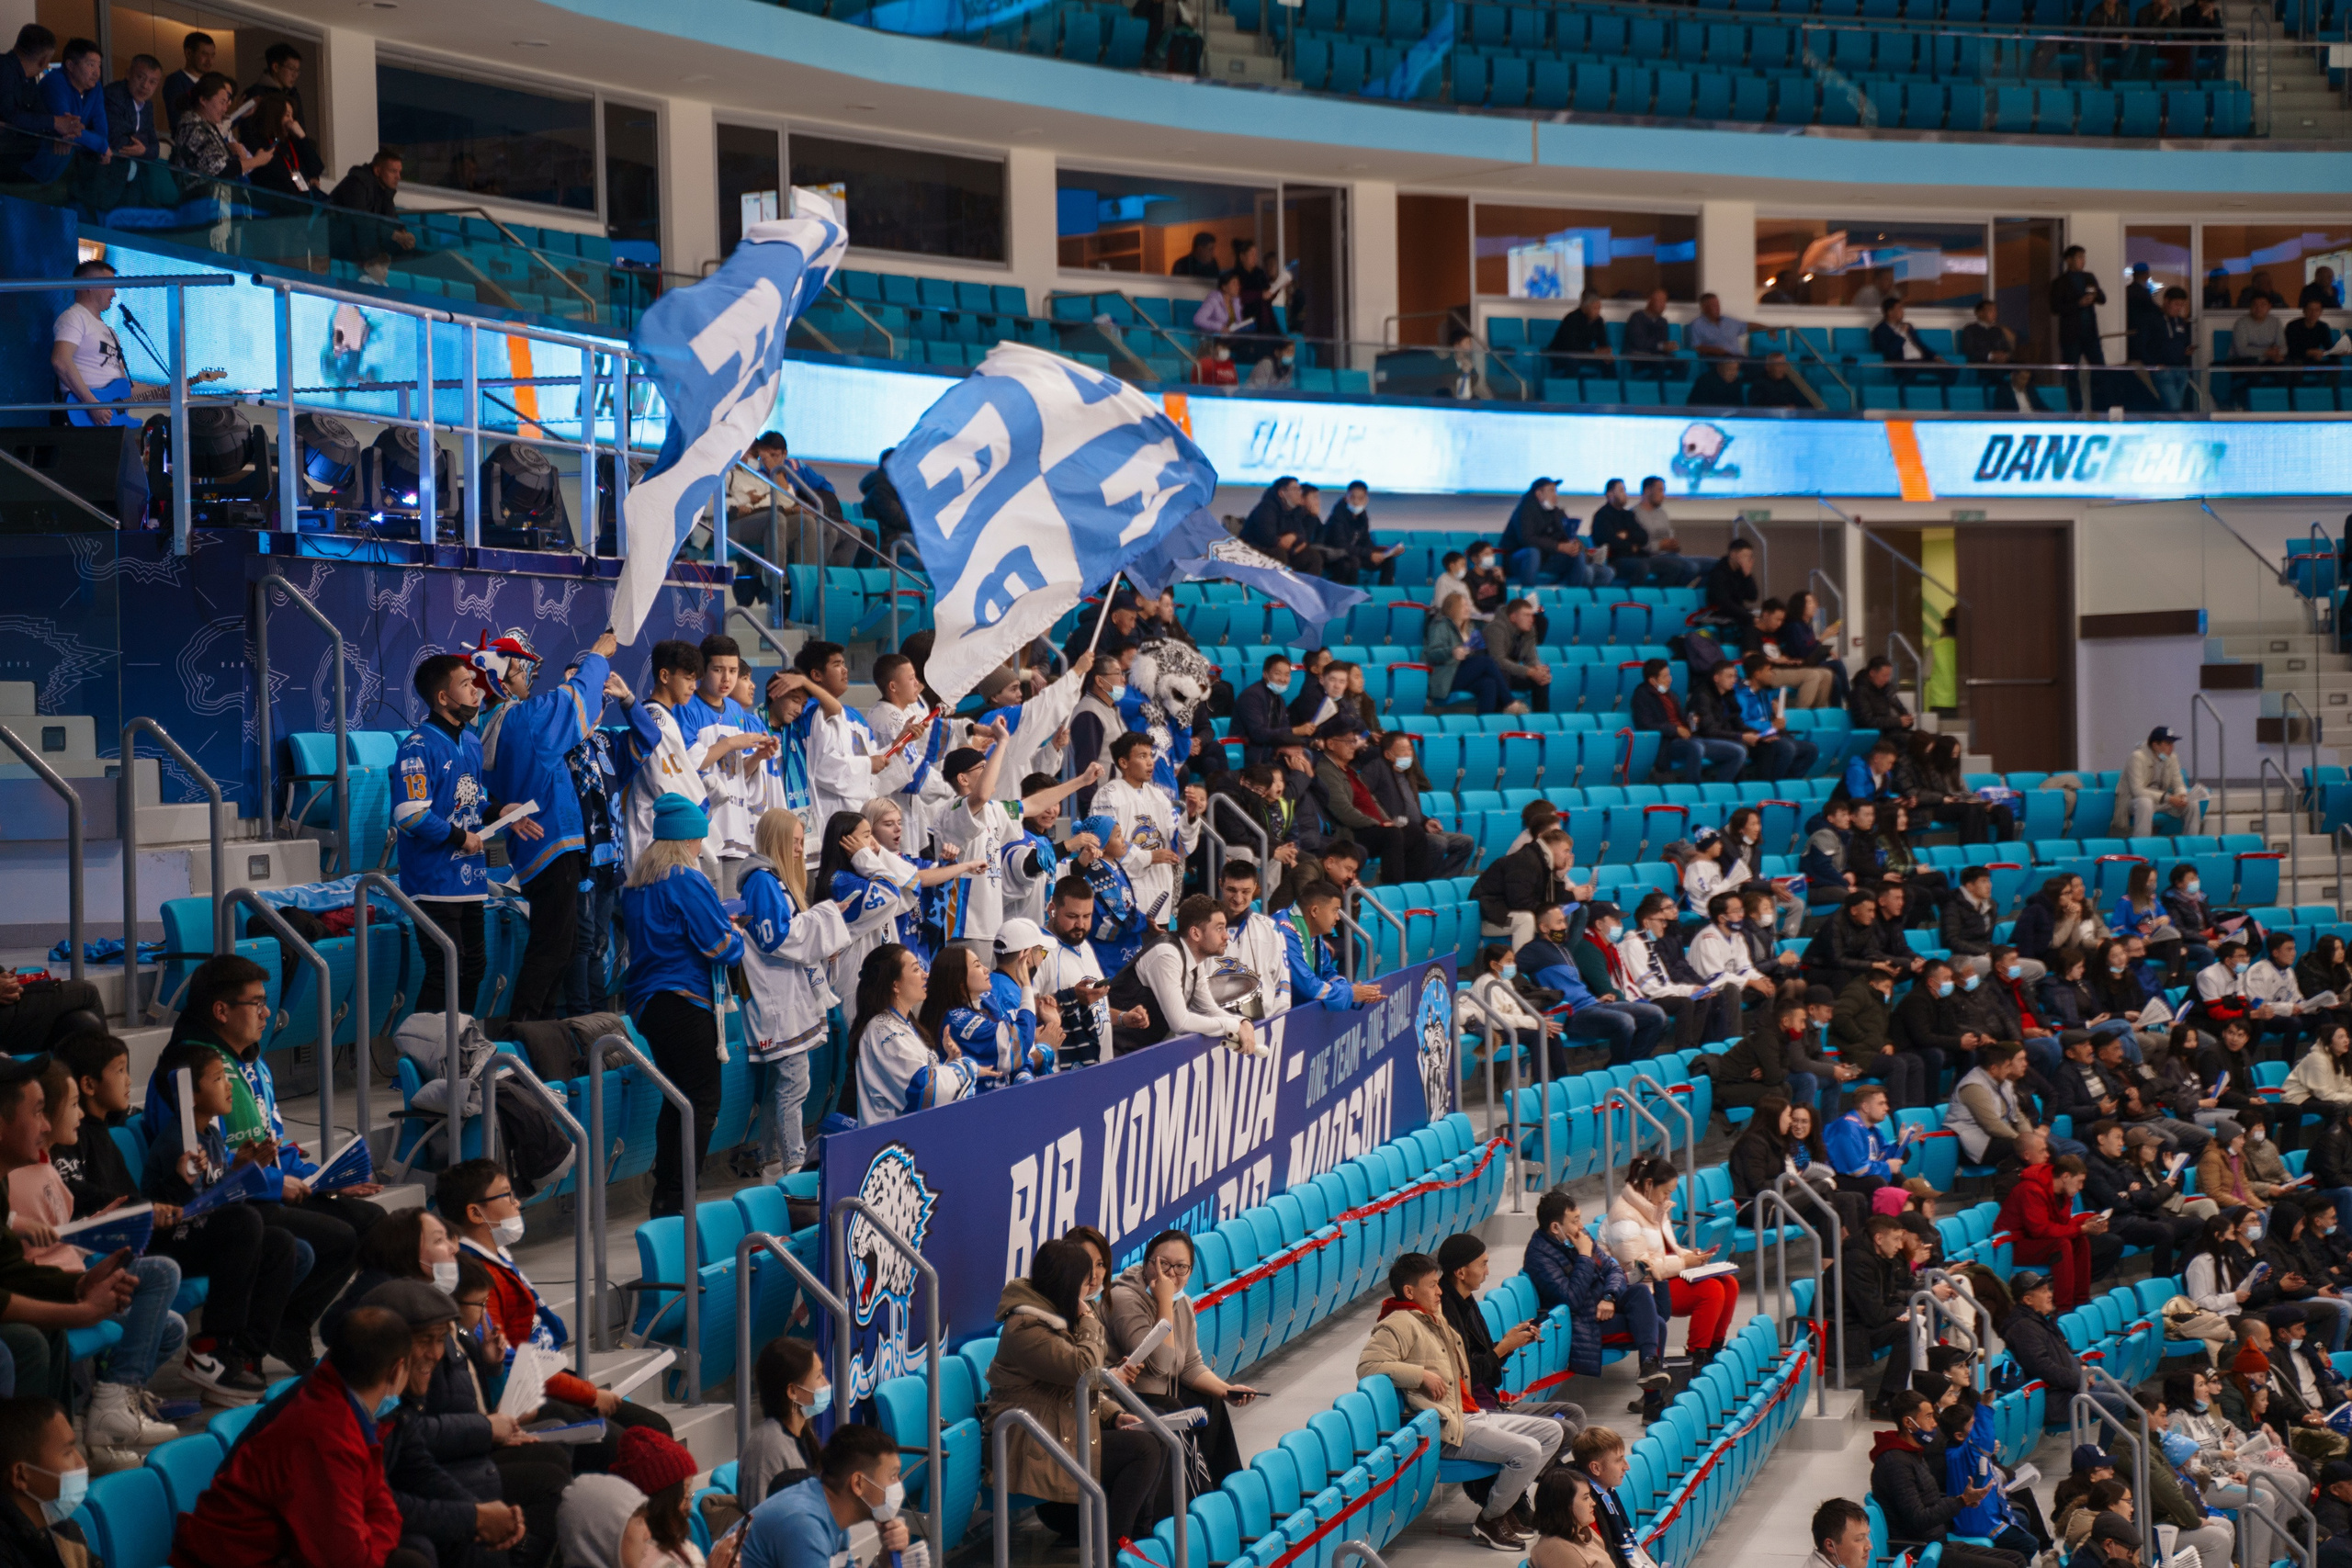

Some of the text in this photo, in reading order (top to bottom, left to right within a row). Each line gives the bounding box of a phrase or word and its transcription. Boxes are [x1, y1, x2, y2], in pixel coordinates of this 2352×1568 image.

[402, 773, 427, 800] 13
[1306, 1045, 1332, 1109] ONE
[1332, 1022, 1362, 1089] TEAM
[1366, 1000, 1386, 1061] ONE
[1387, 980, 1412, 1043] GOAL!
[225, 1126, 262, 1144] 2019
